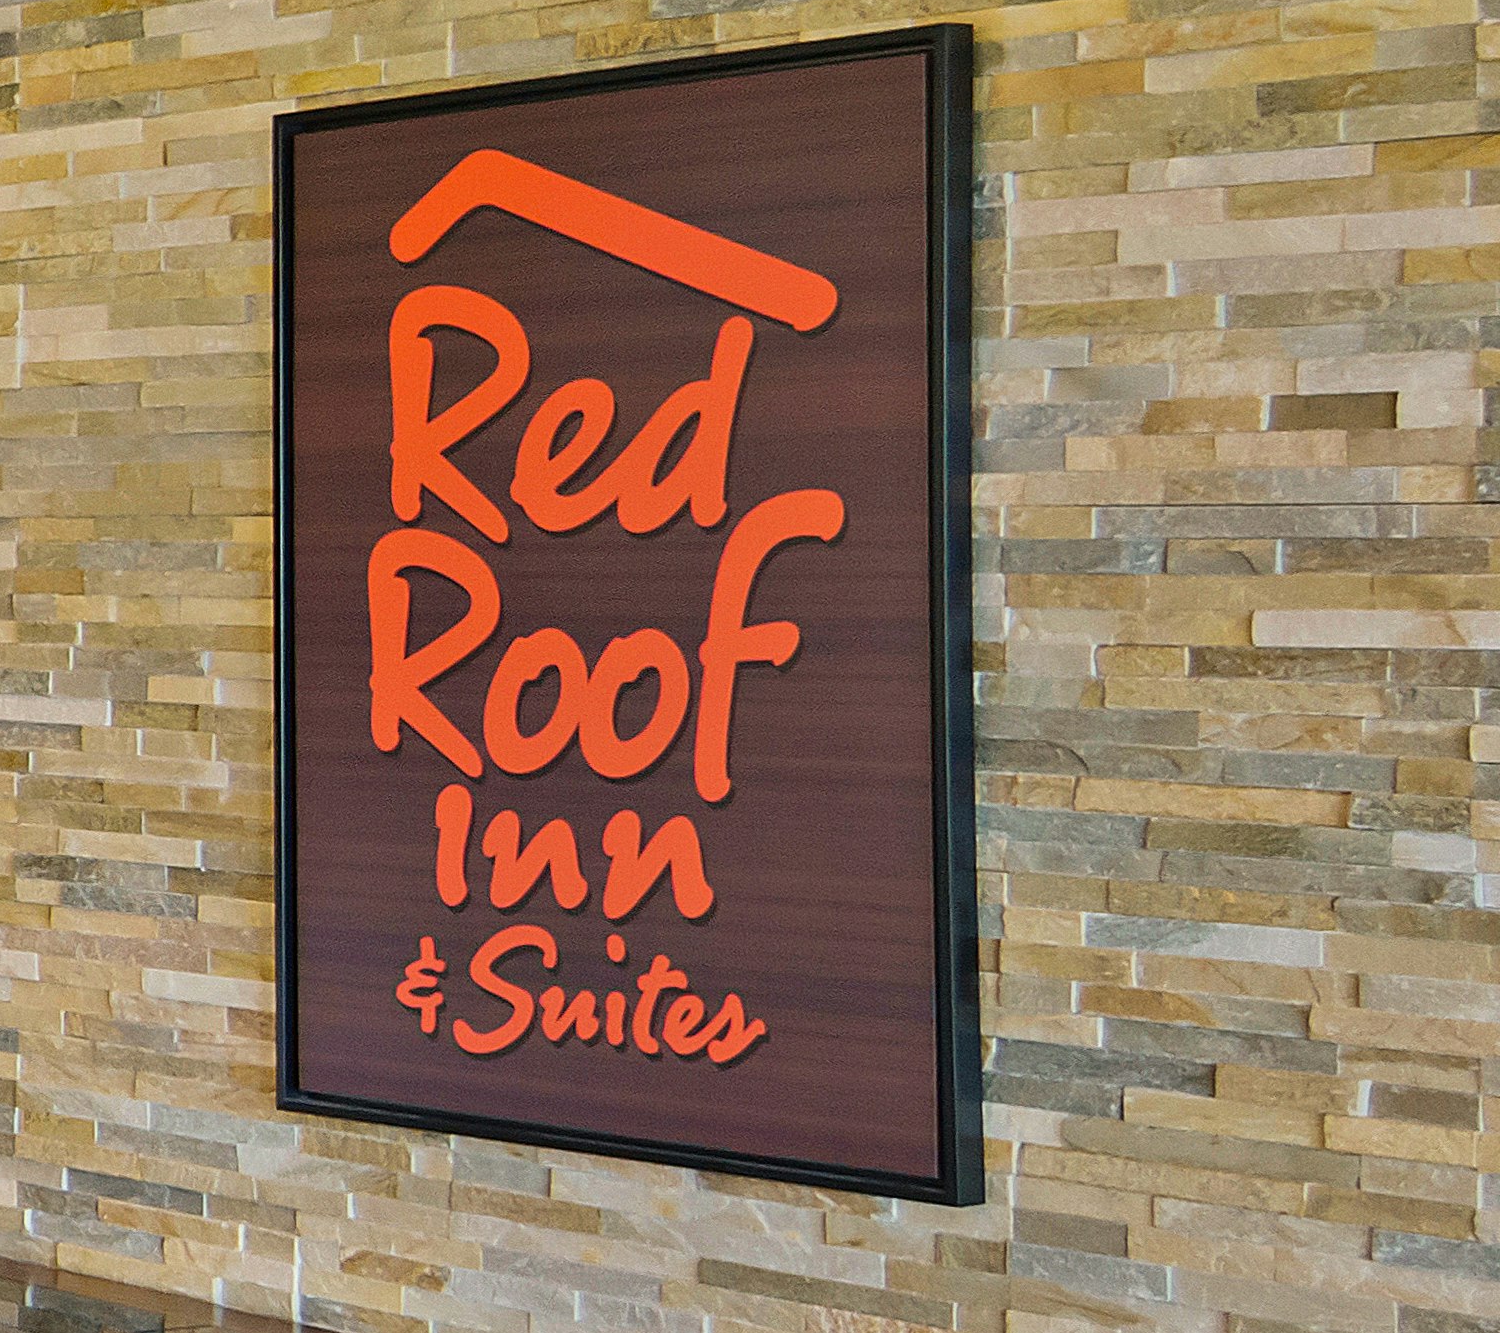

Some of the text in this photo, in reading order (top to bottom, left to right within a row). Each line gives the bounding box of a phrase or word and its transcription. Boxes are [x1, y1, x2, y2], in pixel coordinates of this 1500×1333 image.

[389, 284, 754, 544] Red
[366, 488, 845, 803] Roof
[434, 783, 714, 919] Inn
[396, 924, 766, 1065] & Suites
